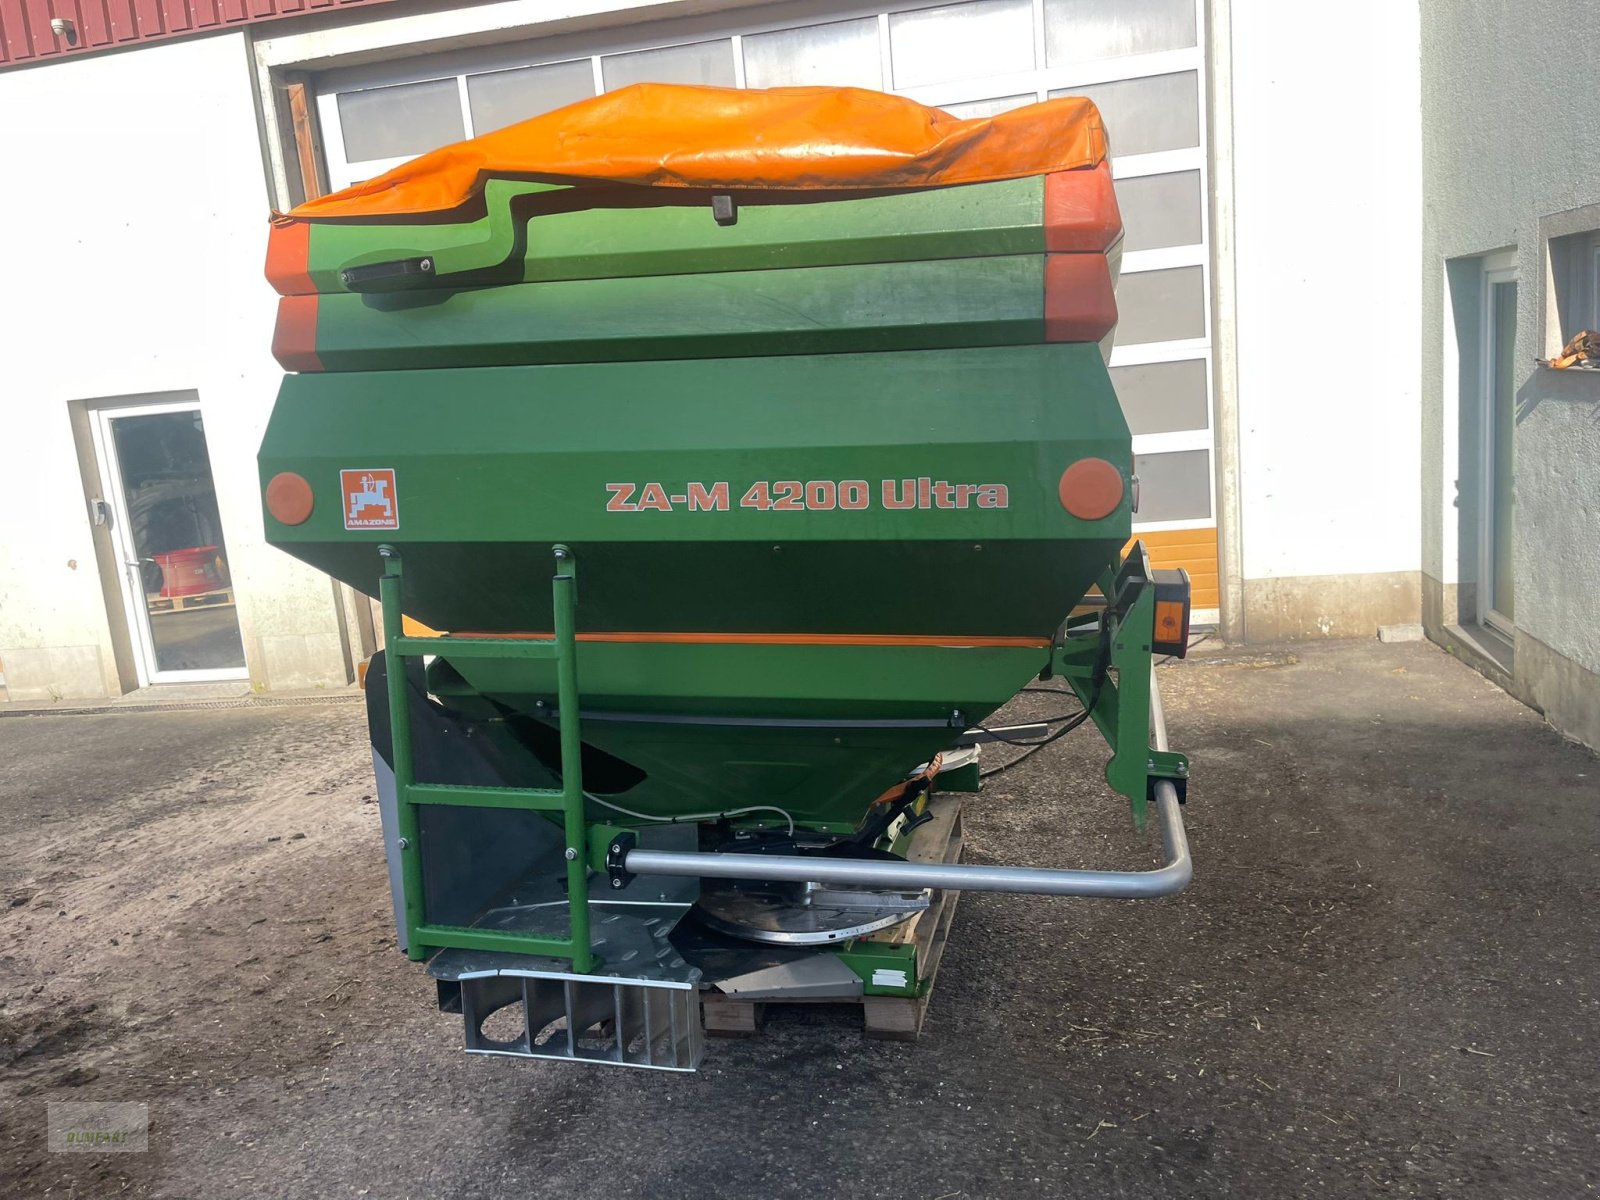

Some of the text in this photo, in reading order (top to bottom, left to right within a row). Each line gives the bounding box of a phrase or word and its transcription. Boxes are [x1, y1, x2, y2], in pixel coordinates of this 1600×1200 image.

[606, 477, 1009, 511] ZA-M 4200 Ultra
